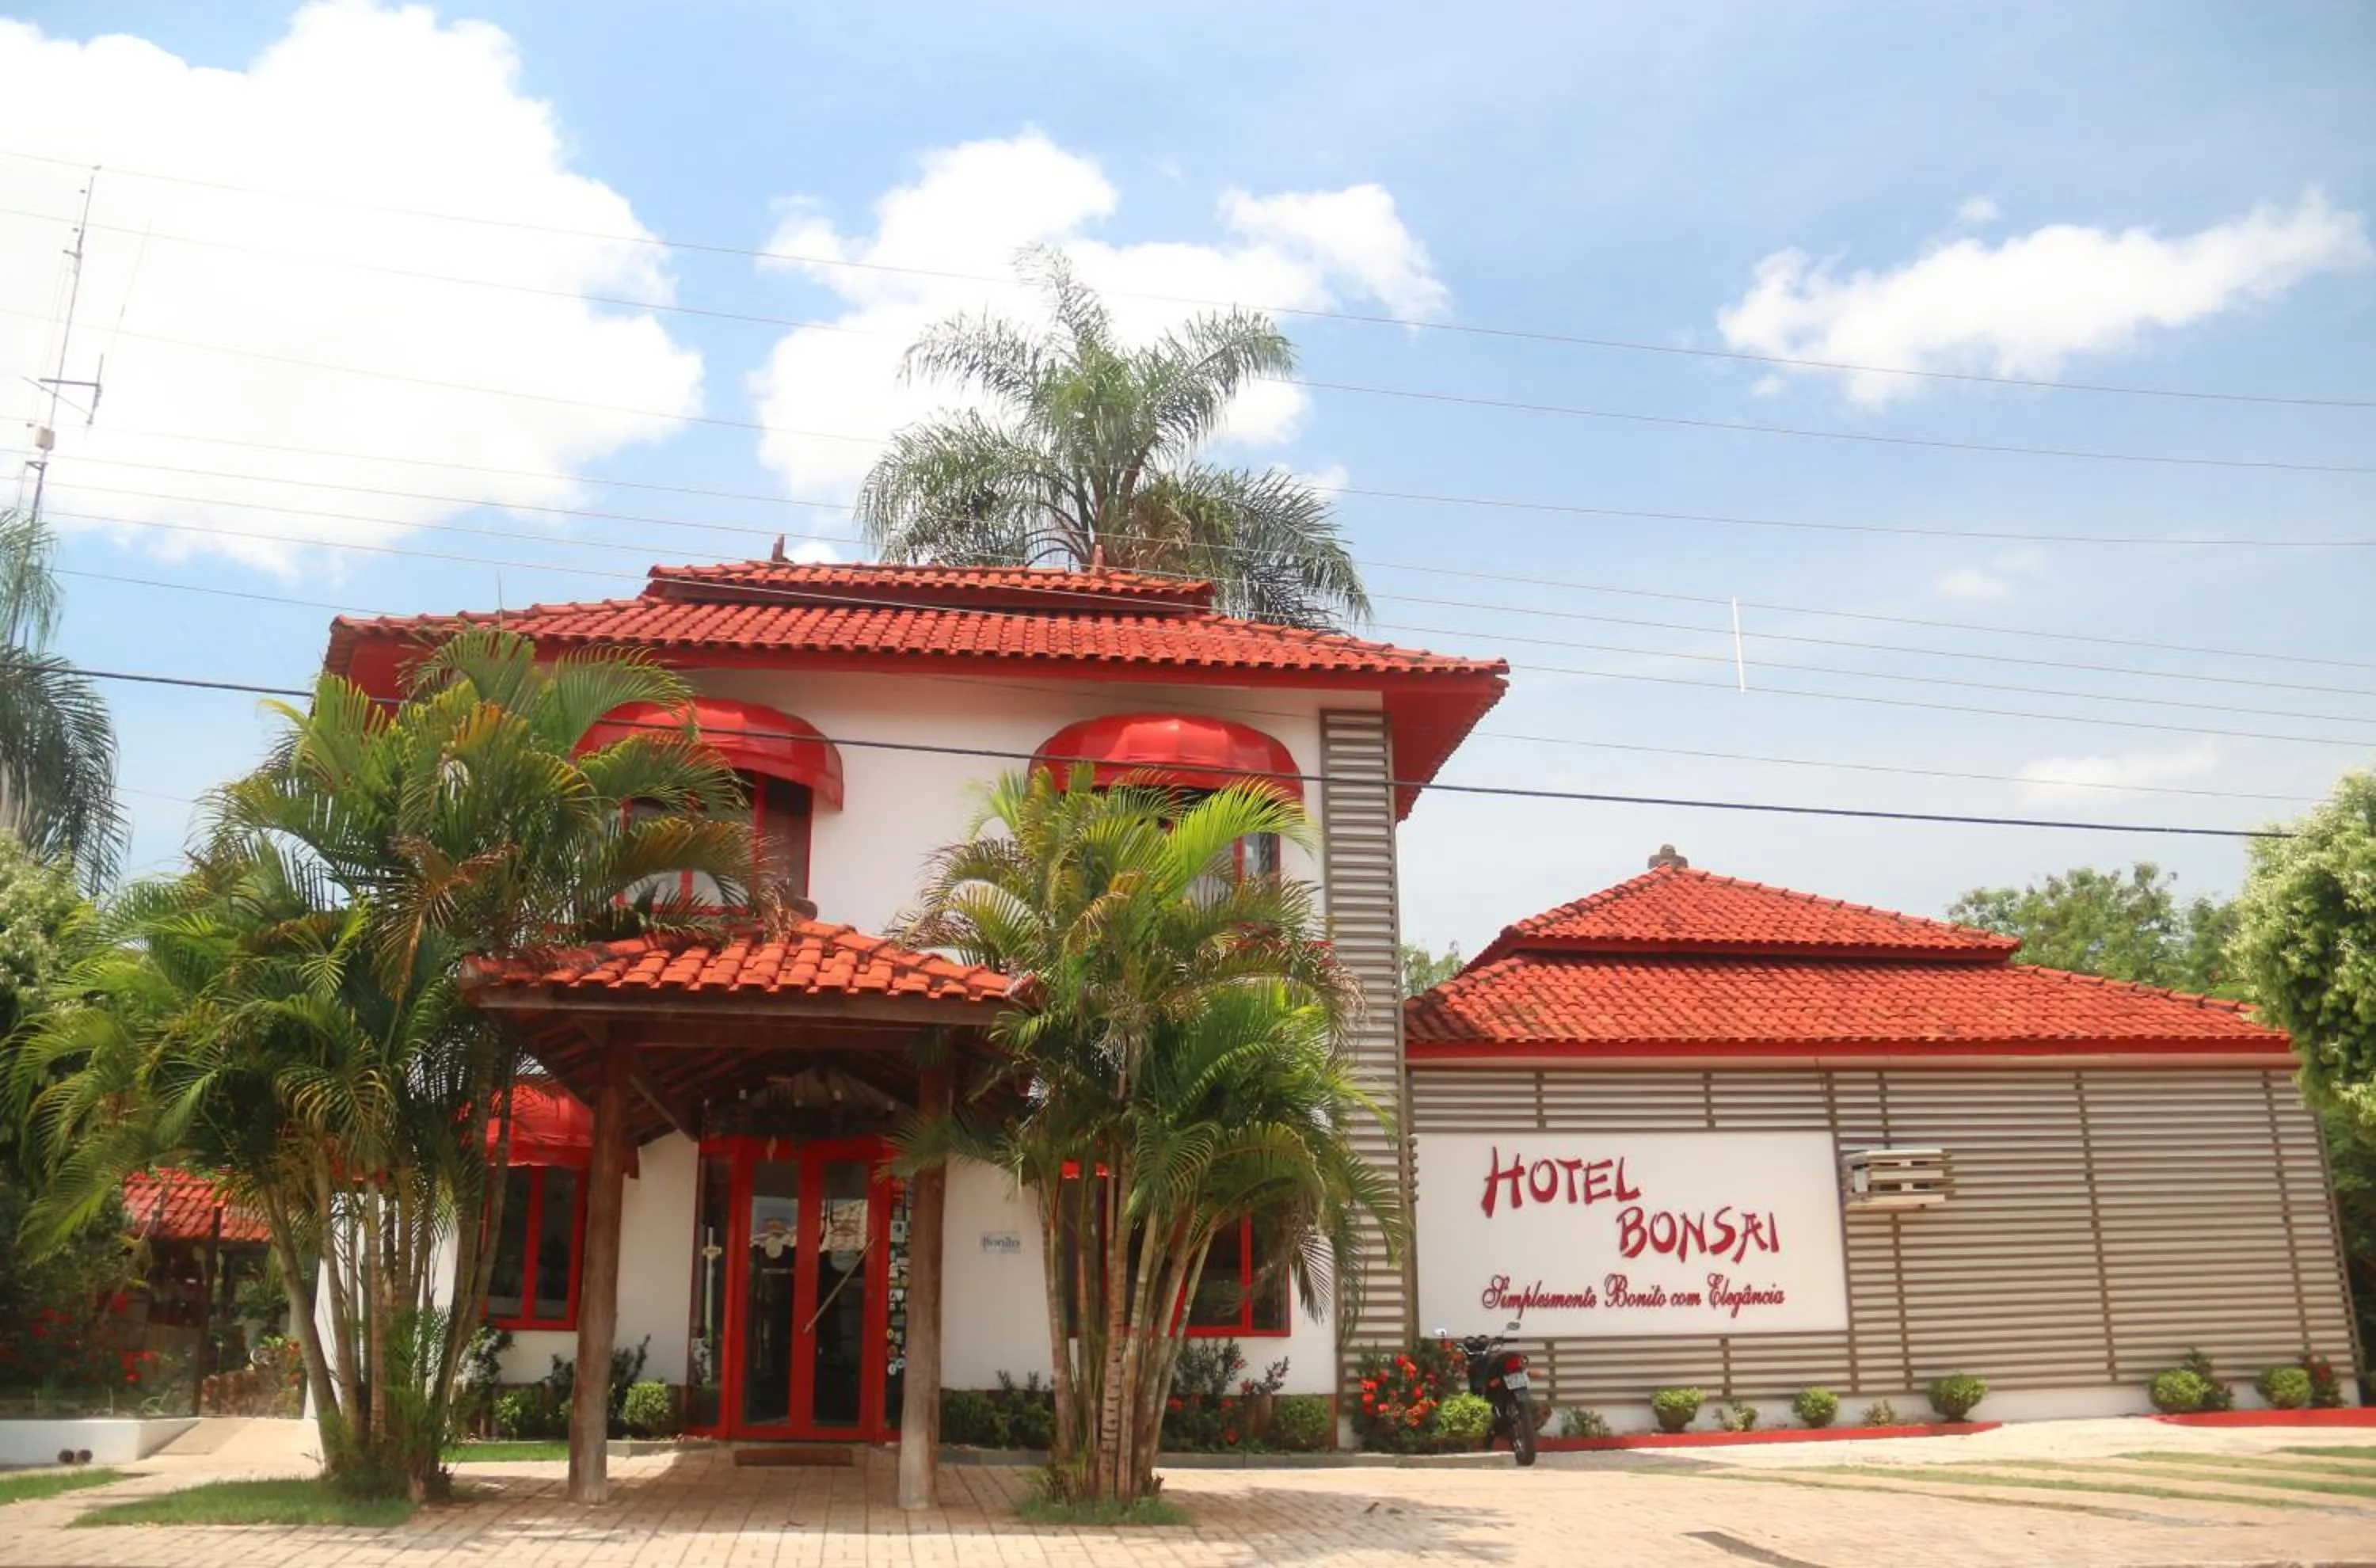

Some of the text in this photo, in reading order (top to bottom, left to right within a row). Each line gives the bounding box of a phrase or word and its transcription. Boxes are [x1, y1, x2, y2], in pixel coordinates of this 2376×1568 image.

[1481, 1146, 1641, 1217] HOTEL
[1616, 1206, 1780, 1264] BONSAI
[1482, 1273, 1785, 1319] Simplesmente Bonito com Elegância
